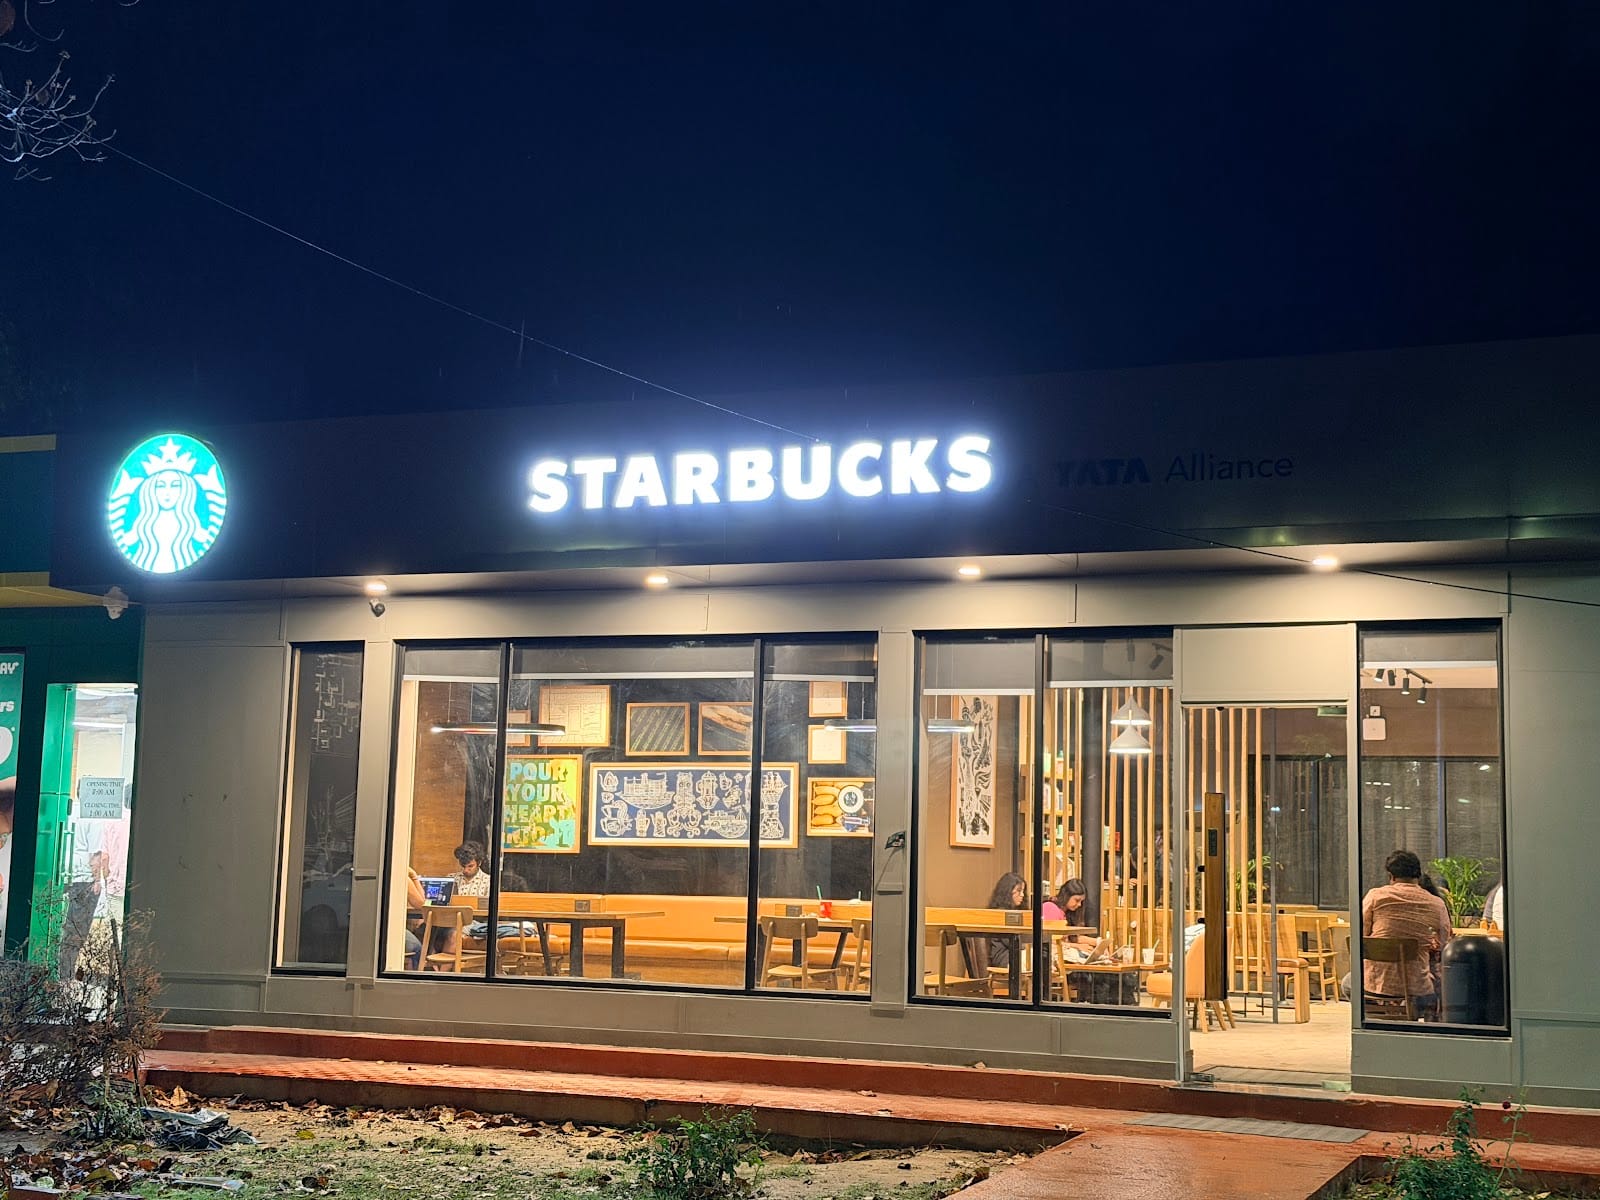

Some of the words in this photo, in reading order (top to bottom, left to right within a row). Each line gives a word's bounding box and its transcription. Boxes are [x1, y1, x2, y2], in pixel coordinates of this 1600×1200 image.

[529, 435, 991, 512] STARBUCKS
[1055, 457, 1152, 487] TATA
[1166, 450, 1294, 482] Alliance
[510, 762, 567, 781] POUR
[507, 783, 567, 802] YOUR
[505, 804, 570, 823] HEART
